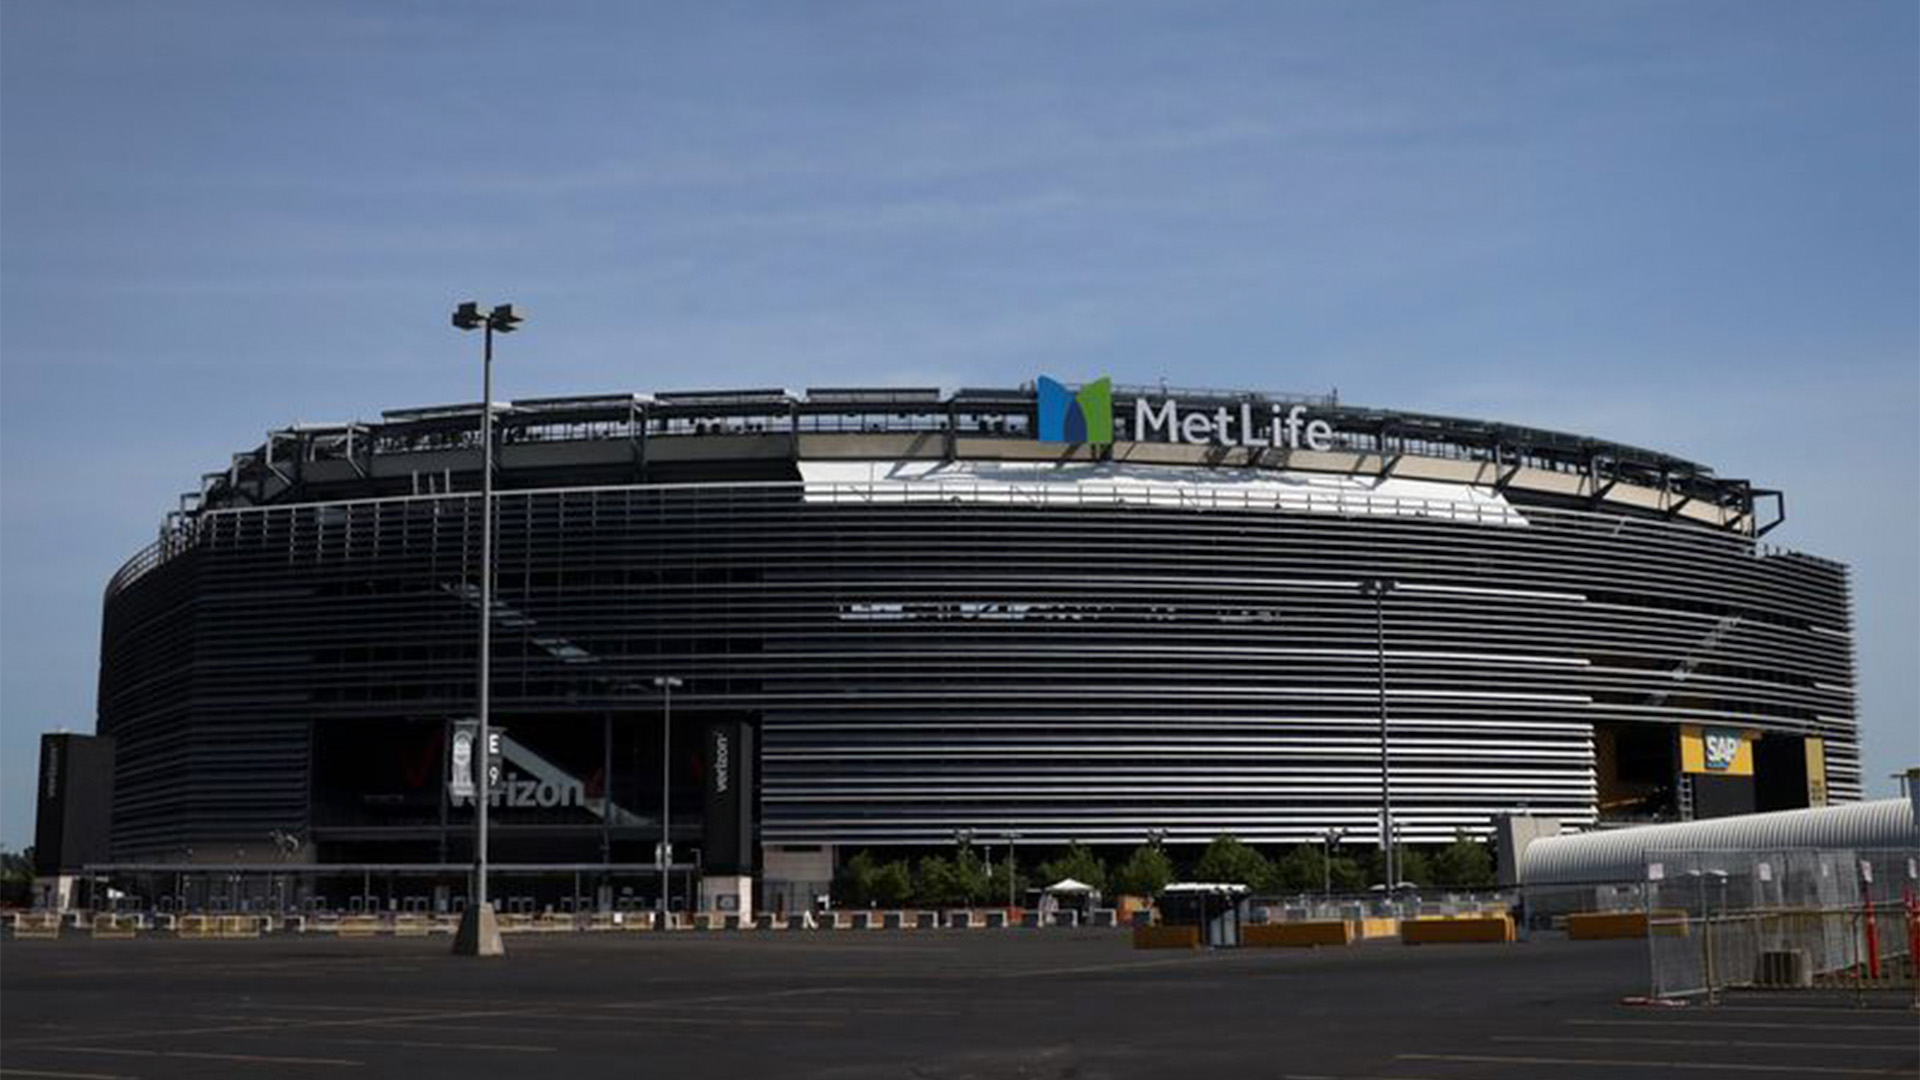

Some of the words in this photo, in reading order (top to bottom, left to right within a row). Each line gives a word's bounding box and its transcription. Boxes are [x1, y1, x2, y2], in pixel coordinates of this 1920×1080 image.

[1134, 398, 1333, 449] MetLife
[488, 733, 500, 754] E
[1706, 736, 1736, 763] SAP
[488, 766, 500, 786] 9
[714, 737, 728, 792] verizon
[447, 771, 585, 808] rizon
